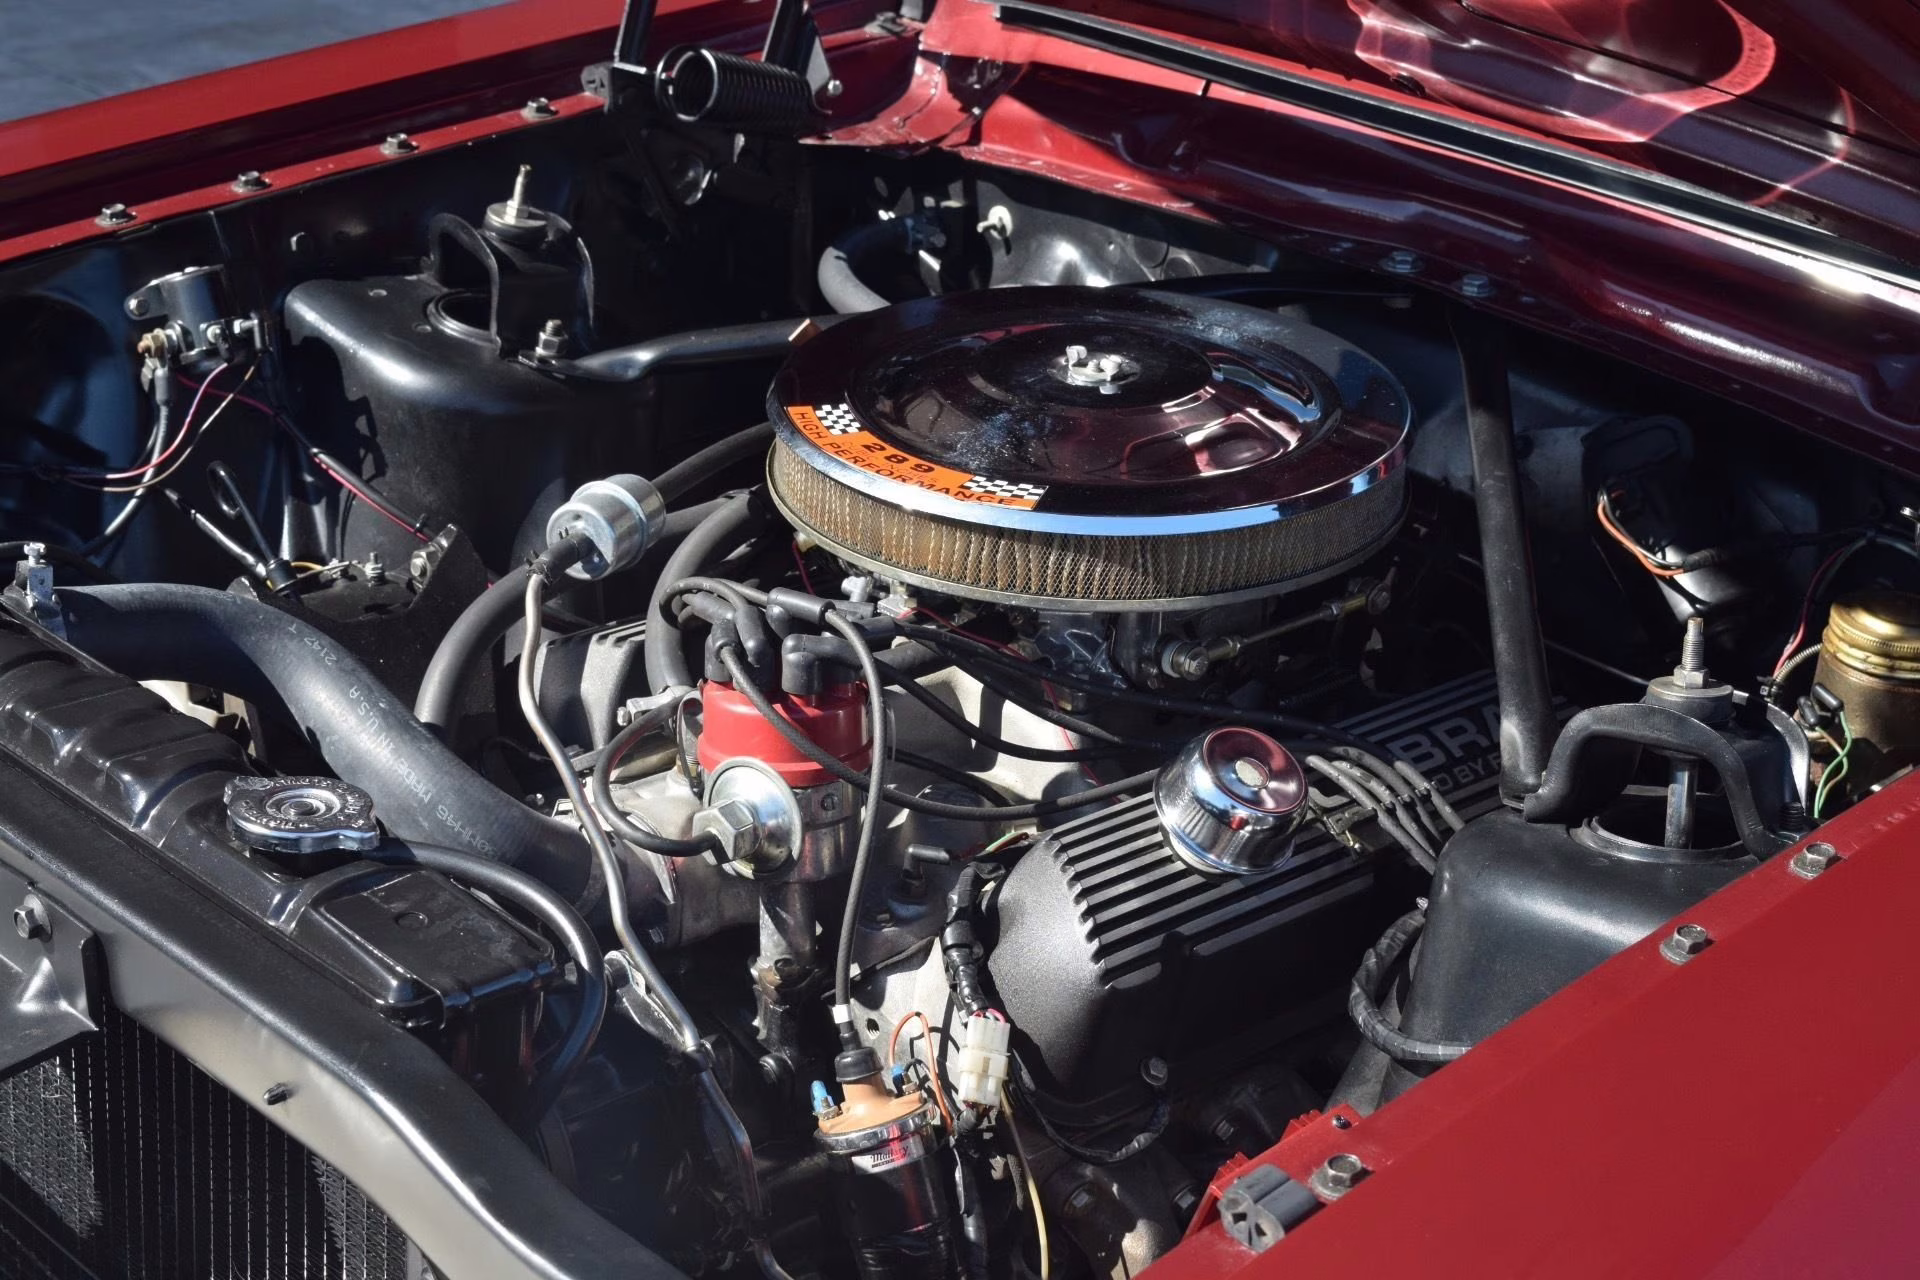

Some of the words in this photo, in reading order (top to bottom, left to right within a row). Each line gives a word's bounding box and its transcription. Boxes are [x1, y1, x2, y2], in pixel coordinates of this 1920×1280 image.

[793, 412, 828, 439] HIGH
[822, 442, 1017, 506] PERFORMANCE
[861, 442, 936, 474] 289
[303, 635, 338, 666] 2147
[398, 757, 434, 804] MADE
